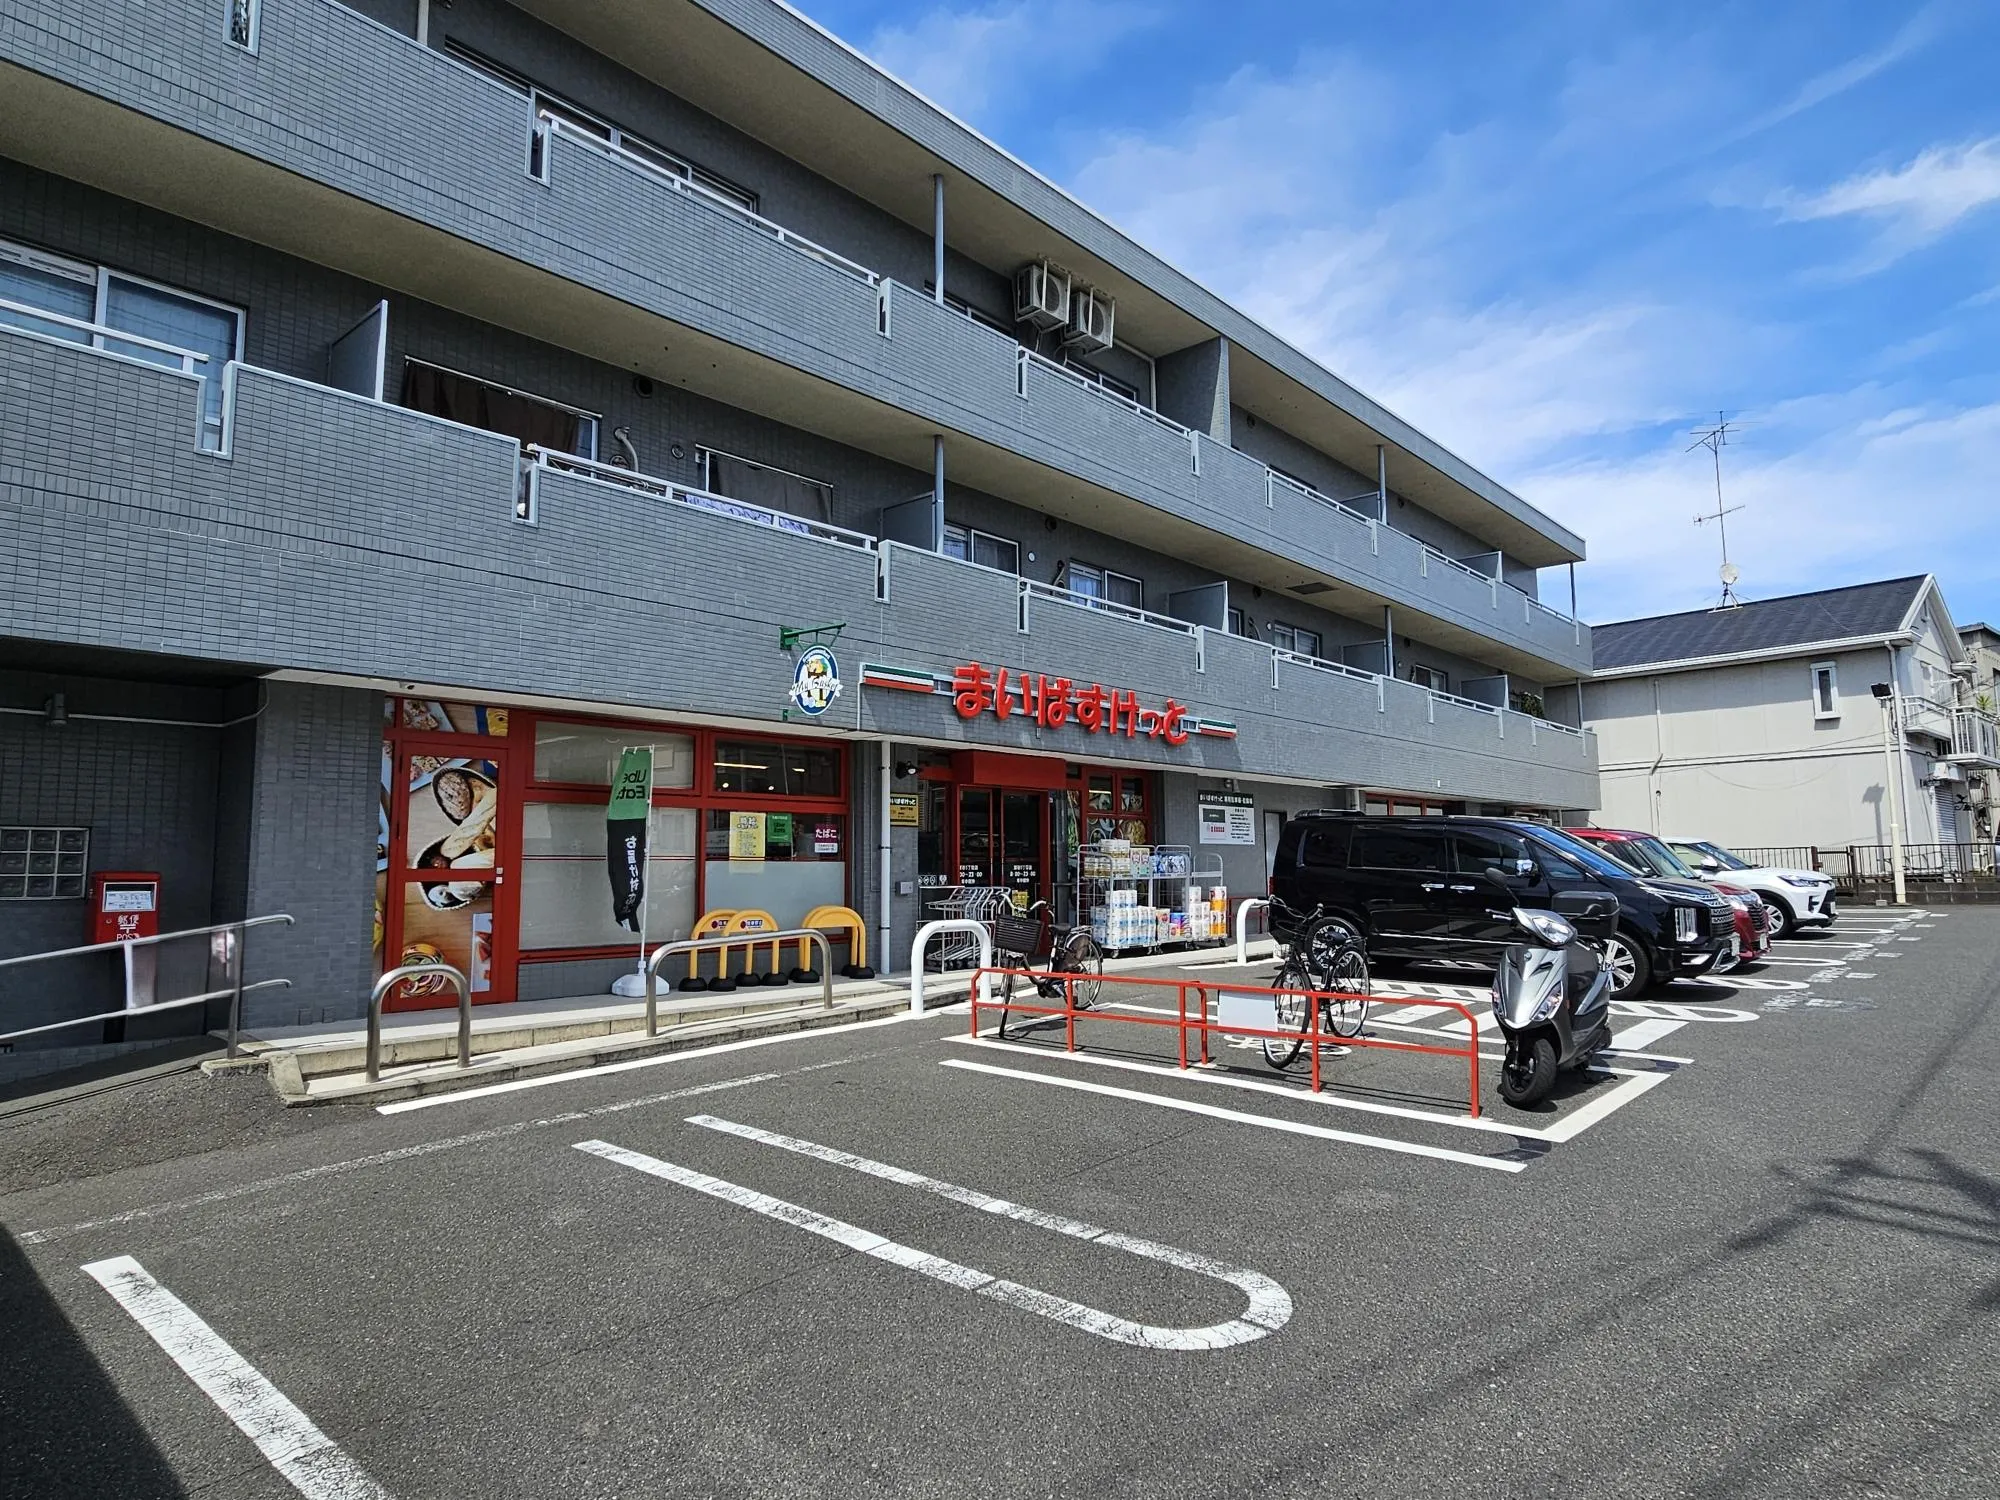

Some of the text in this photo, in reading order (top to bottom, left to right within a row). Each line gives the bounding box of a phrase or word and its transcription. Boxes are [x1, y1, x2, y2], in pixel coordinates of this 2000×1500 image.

[953, 661, 1188, 746] まいばすけっと
[815, 828, 837, 839] たばこ
[117, 914, 140, 925] 郵便
